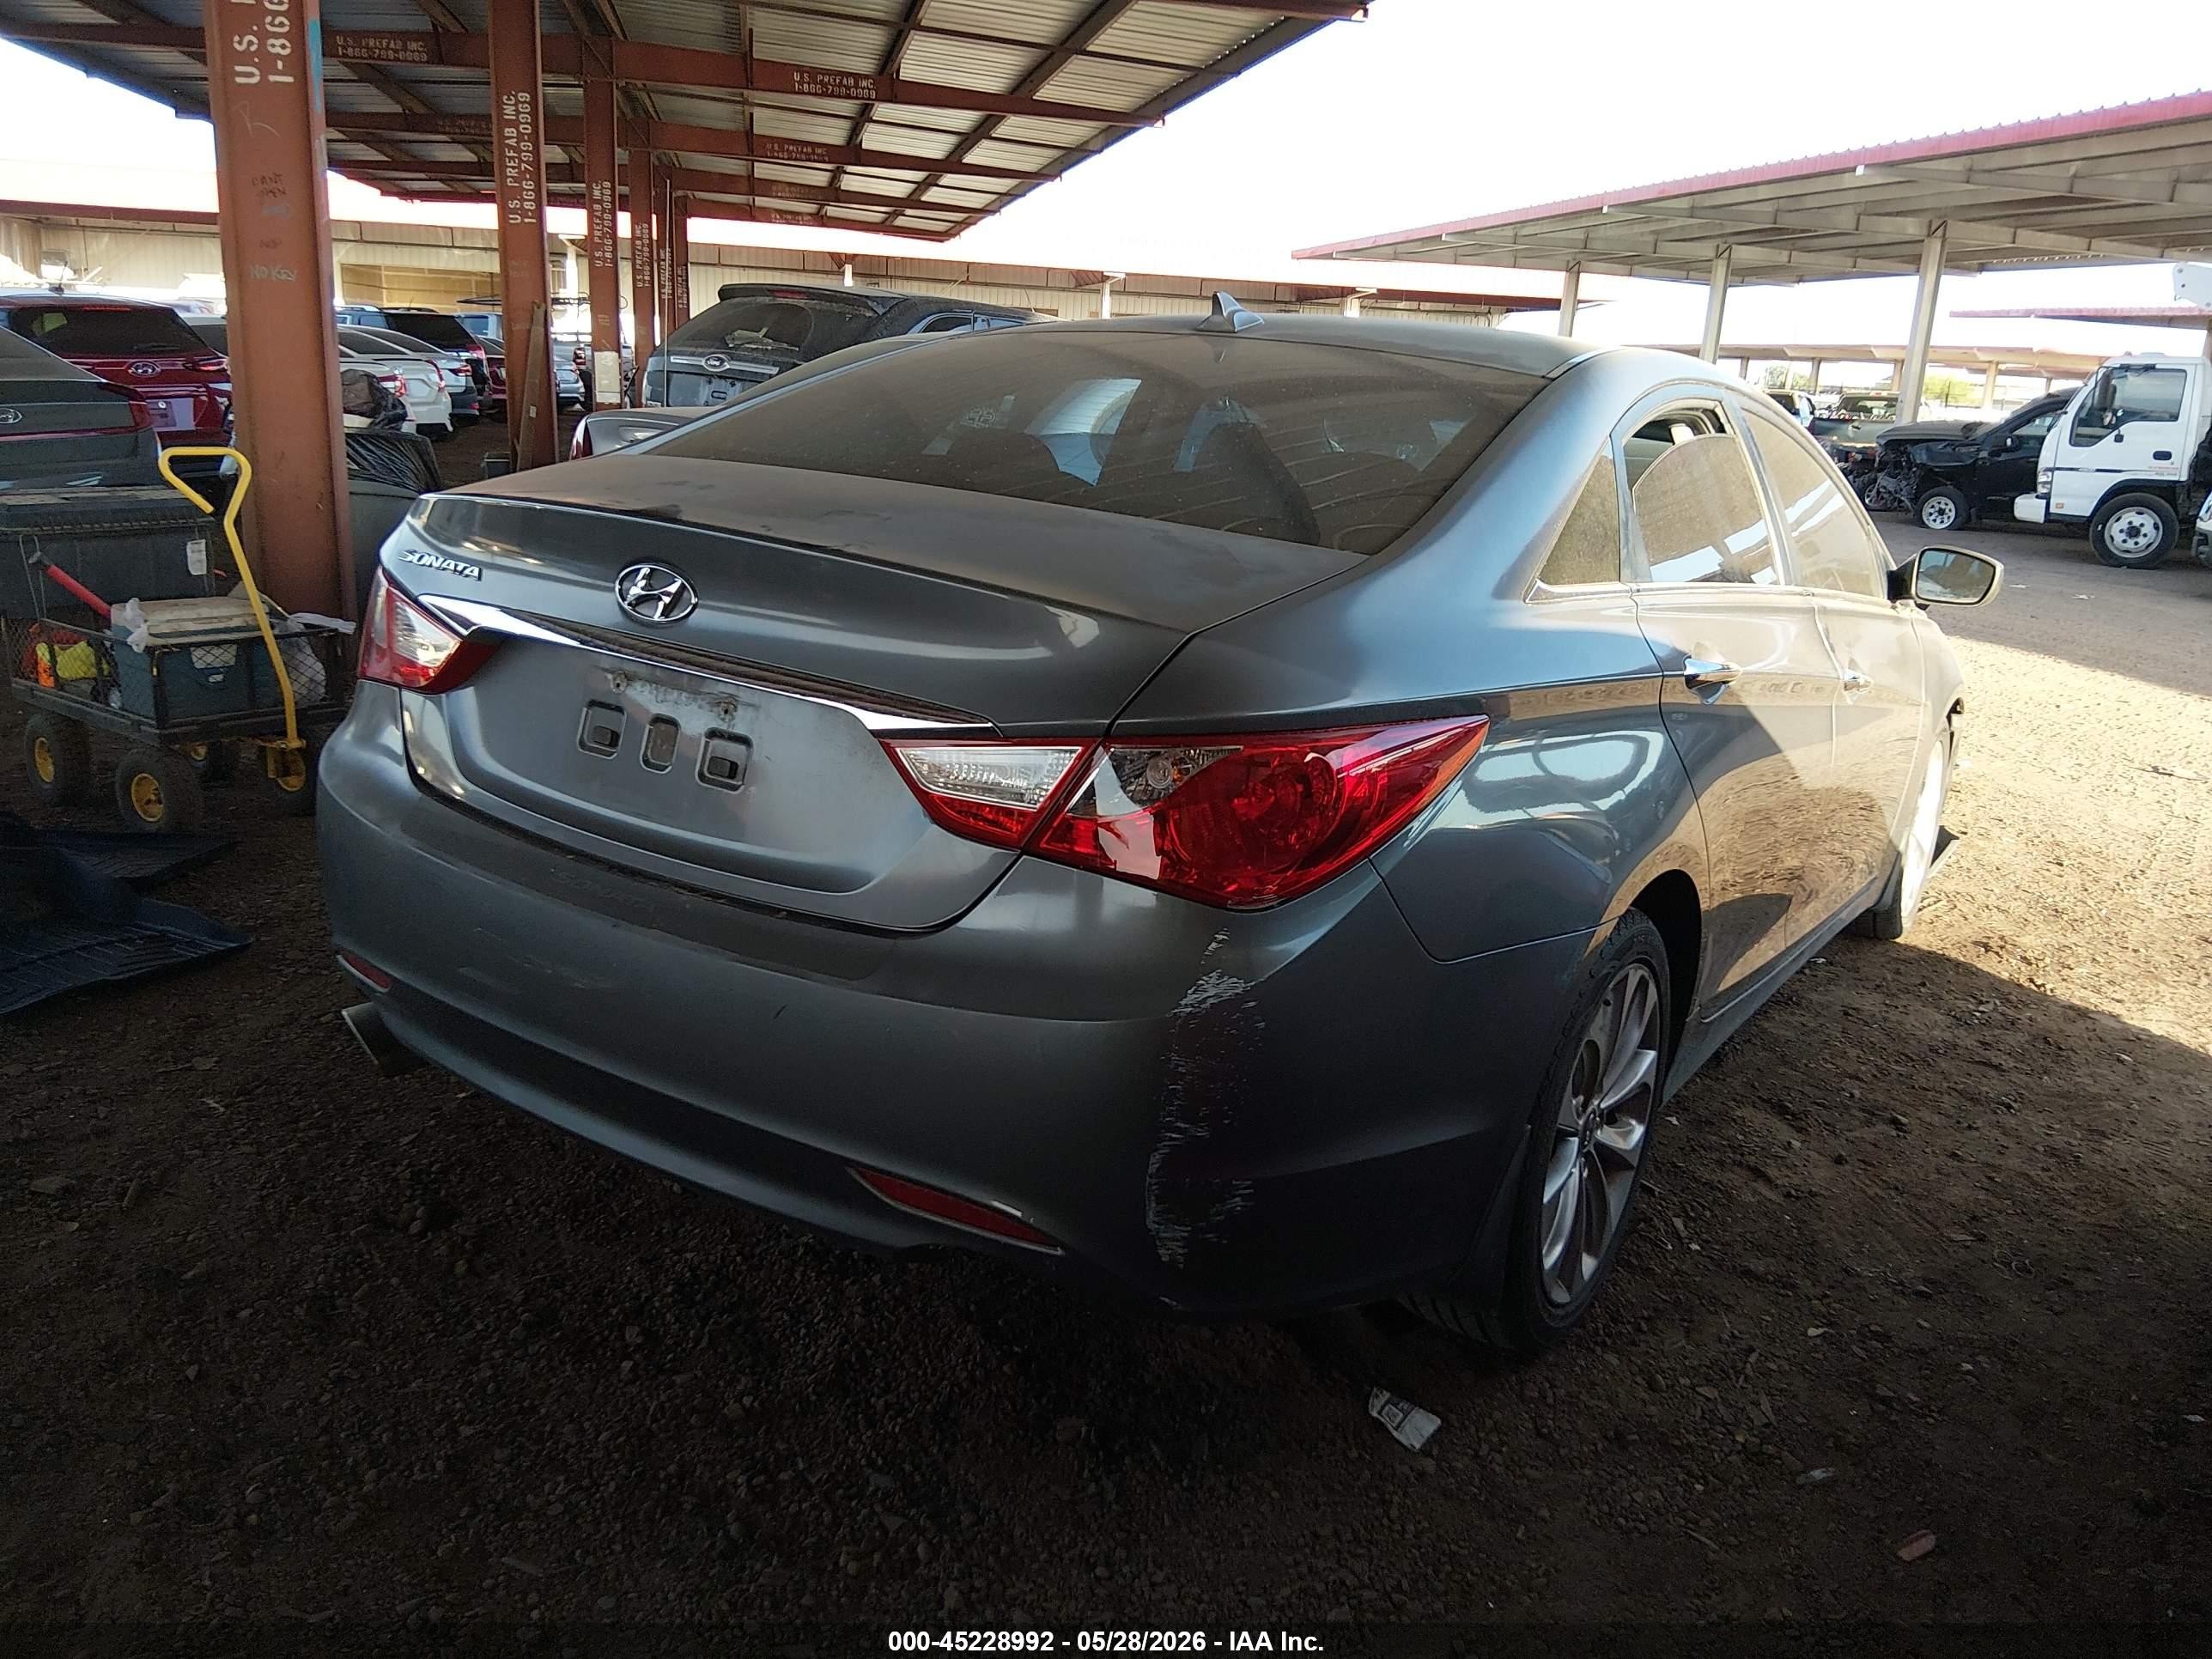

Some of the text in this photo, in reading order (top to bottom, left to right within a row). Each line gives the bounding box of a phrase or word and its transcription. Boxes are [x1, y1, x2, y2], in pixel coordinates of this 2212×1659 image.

[234, 25, 261, 84] U.S.
[362, 37, 403, 50] PREFAB
[817, 74, 854, 87] PREFAB
[859, 77, 877, 89] INC.
[502, 90, 522, 224] U.S. PREFAB INC.
[517, 92, 538, 223] 1-866-799-0969
[592, 180, 604, 267] U.S. PREFAB INC.
[397, 549, 483, 582] SONATA
